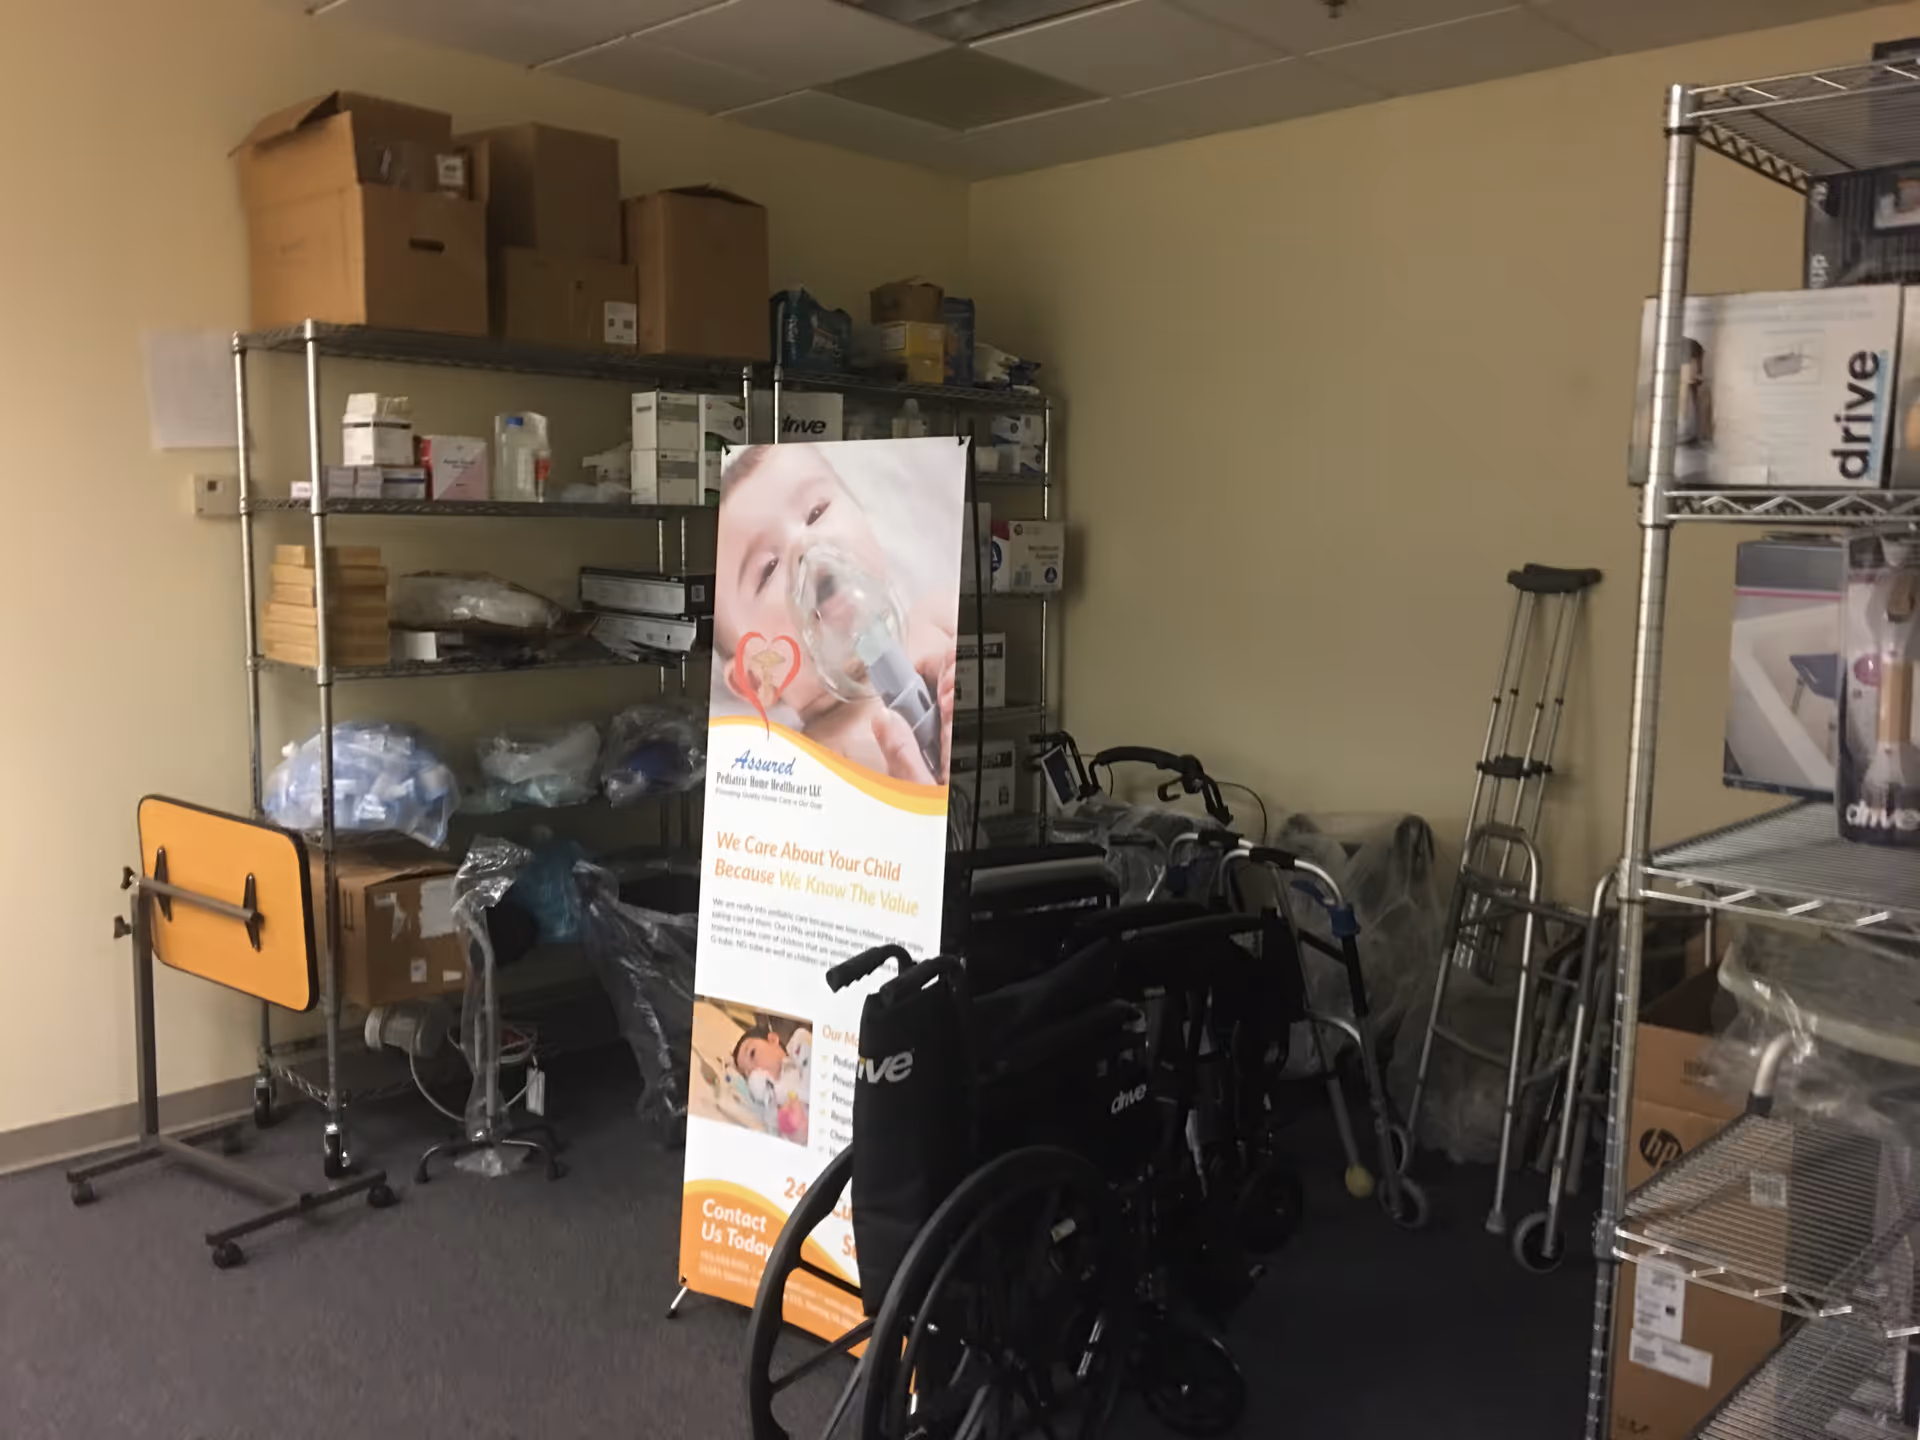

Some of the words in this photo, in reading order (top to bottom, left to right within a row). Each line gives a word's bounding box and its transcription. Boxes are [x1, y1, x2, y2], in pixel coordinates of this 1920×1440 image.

[1831, 351, 1879, 479] drive
[731, 748, 796, 775] Assured
[716, 771, 747, 787] Pediatric
[749, 775, 769, 790] Home
[770, 778, 807, 795] Healthcare
[809, 784, 822, 797] LLC
[1846, 799, 1920, 830] drive
[717, 831, 741, 851] We
[744, 835, 778, 857] Care
[780, 841, 824, 867] About
[828, 850, 861, 873] Your
[863, 856, 902, 882] Child
[715, 858, 775, 885] Because
[779, 869, 801, 890] We
[805, 875, 846, 898] Know
[850, 882, 876, 906] The
[880, 889, 919, 916] Value
[823, 1024, 841, 1041] Our
[1111, 1084, 1147, 1114] drive
[1644, 1128, 1679, 1169] hp
[702, 1198, 767, 1233] Contact
[701, 1221, 722, 1243] Us
[727, 1227, 774, 1263] Today
